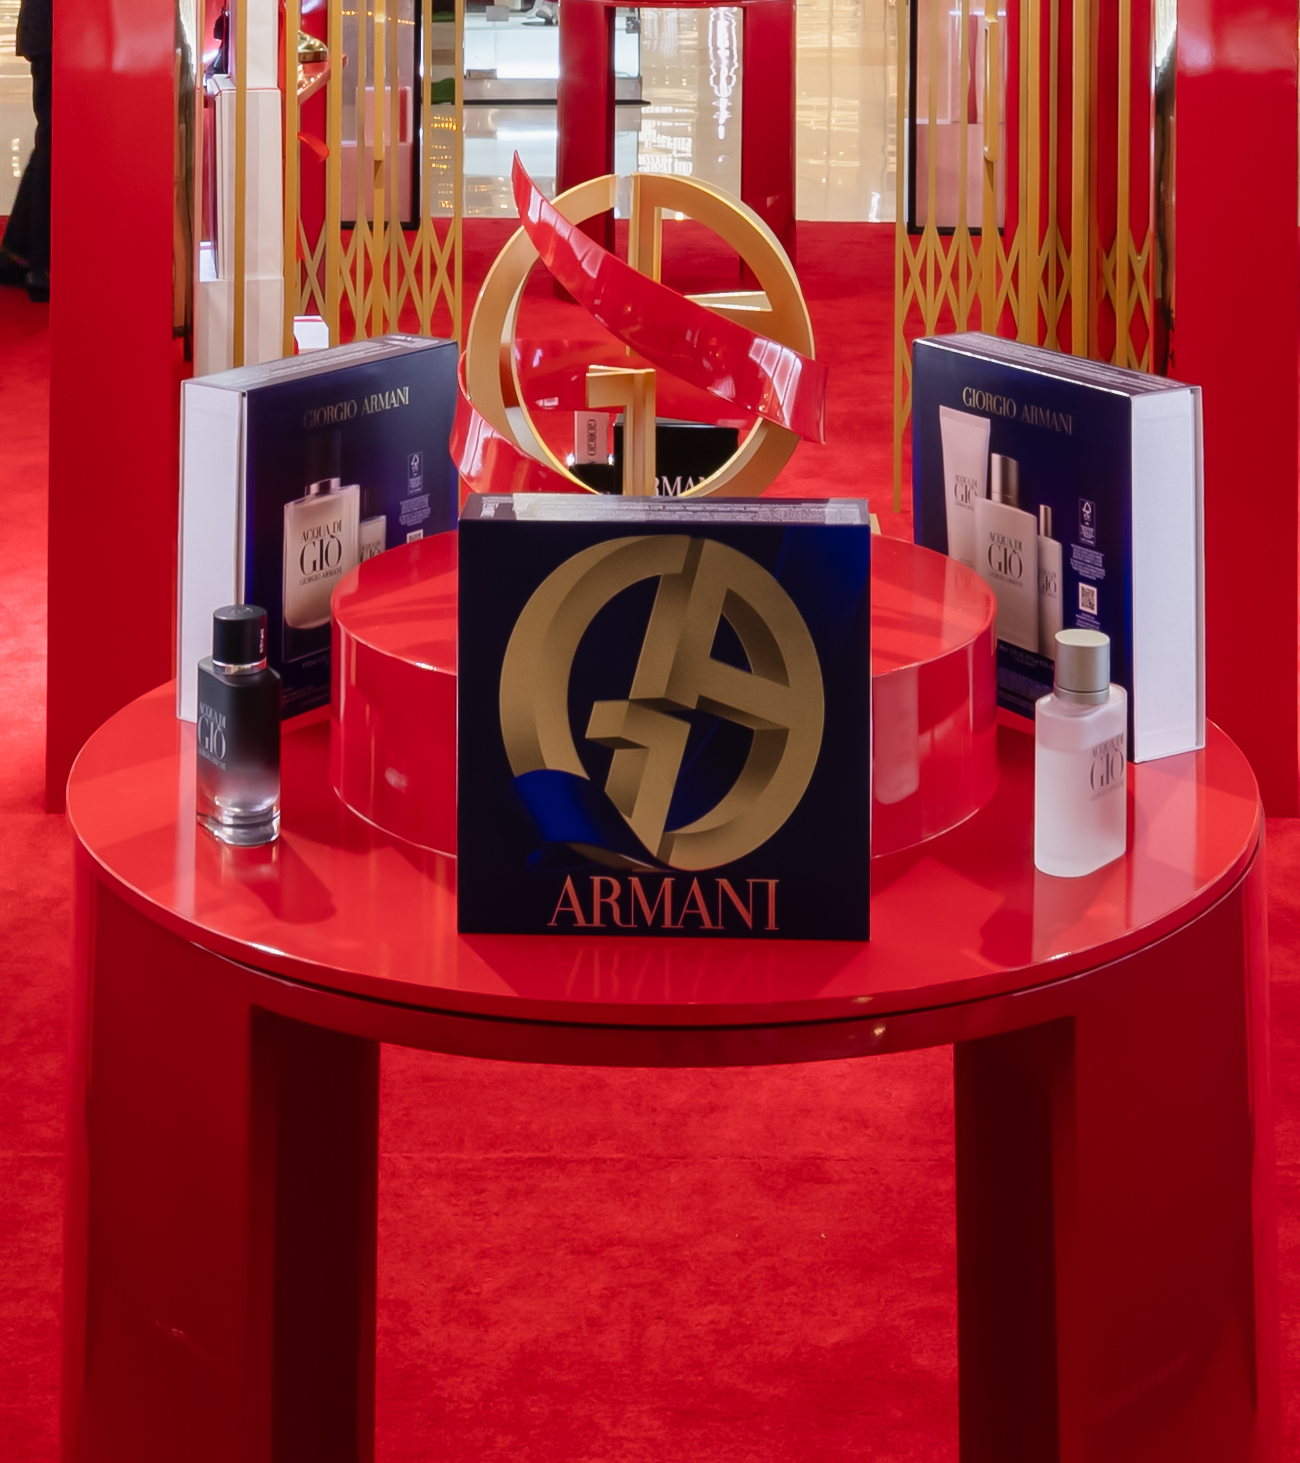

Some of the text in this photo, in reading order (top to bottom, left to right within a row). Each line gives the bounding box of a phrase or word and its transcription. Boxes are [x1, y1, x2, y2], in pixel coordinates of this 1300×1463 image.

[303, 386, 410, 430] GIORGIO ARMANI
[962, 386, 1073, 435] GIORGIO ARMANI
[302, 519, 342, 543] ACQUA DI
[989, 532, 1023, 553] ACQUA DI
[546, 874, 780, 931] ARMANI
